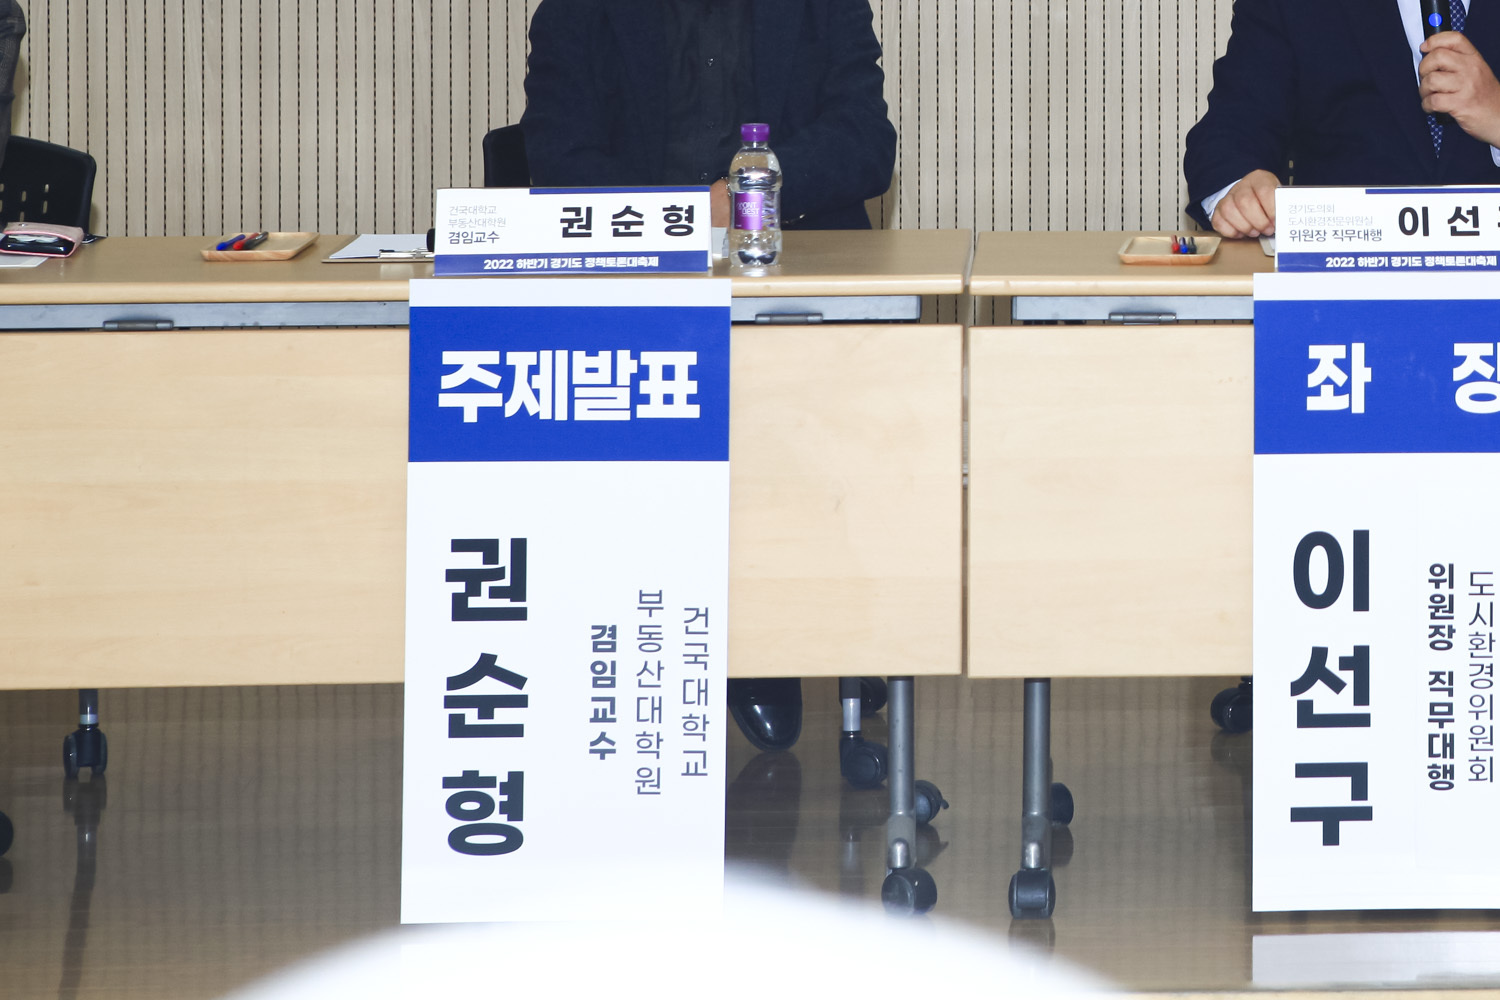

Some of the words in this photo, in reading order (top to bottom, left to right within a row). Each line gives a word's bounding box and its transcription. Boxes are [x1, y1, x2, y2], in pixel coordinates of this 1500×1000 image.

[449, 231, 499, 244] 겸임교수
[484, 259, 514, 269] 2022
[516, 258, 548, 269] 하반기
[551, 258, 582, 268] 경기도
[585, 257, 658, 268] 정책토론대축제
[1290, 230, 1327, 242] 위원장
[1333, 229, 1381, 241] 직무대행
[1326, 257, 1355, 267] 2022
[1357, 257, 1388, 267] 하반기
[1391, 257, 1422, 267] 경기도
[1425, 256, 1496, 266] 정책토론대축제
[439, 350, 700, 422] 주제발표
[1428, 564, 1456, 650] 위원장
[442, 538, 528, 856] 권순형
[589, 625, 617, 760] 겸임교수
[635, 590, 664, 794] 부동산대학원
[681, 607, 709, 776] 건국대학교
[1291, 530, 1372, 846] 이선구
[1427, 671, 1454, 790] 직무대행
[1469, 572, 1495, 782] 도시환경위원회
